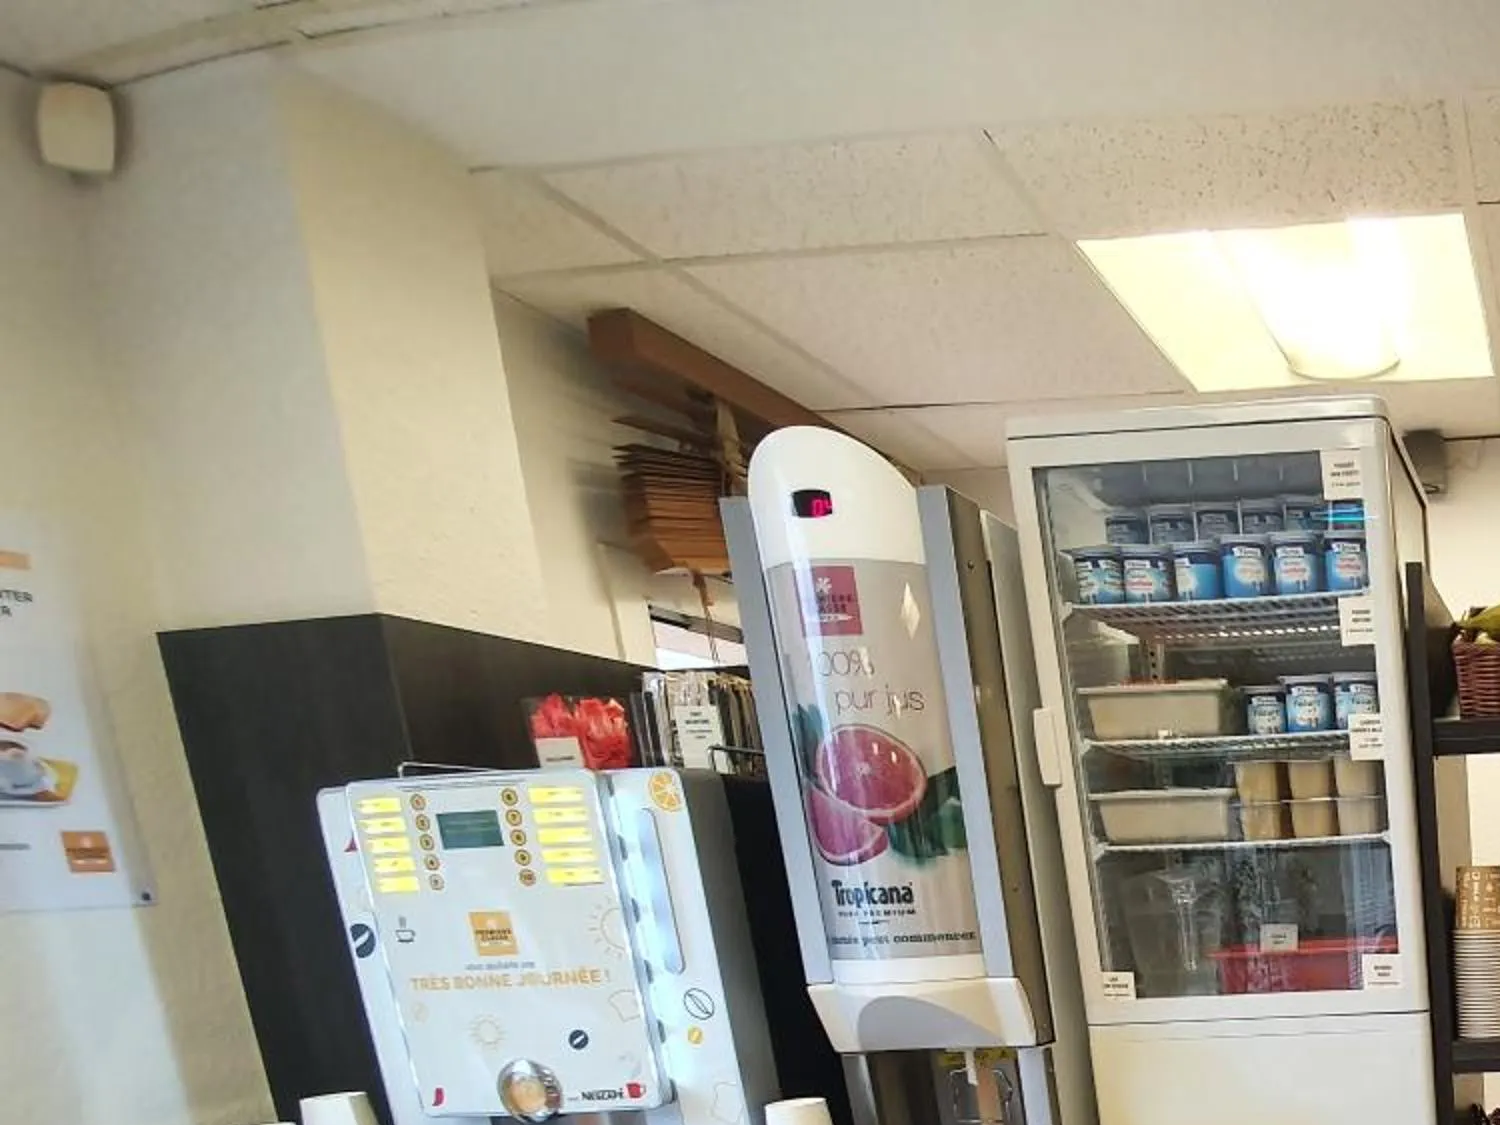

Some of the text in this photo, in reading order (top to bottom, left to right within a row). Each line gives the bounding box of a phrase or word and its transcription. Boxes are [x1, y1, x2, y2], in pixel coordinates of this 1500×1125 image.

[834, 684, 926, 715] pur jus
[831, 879, 915, 908] Tropicana
